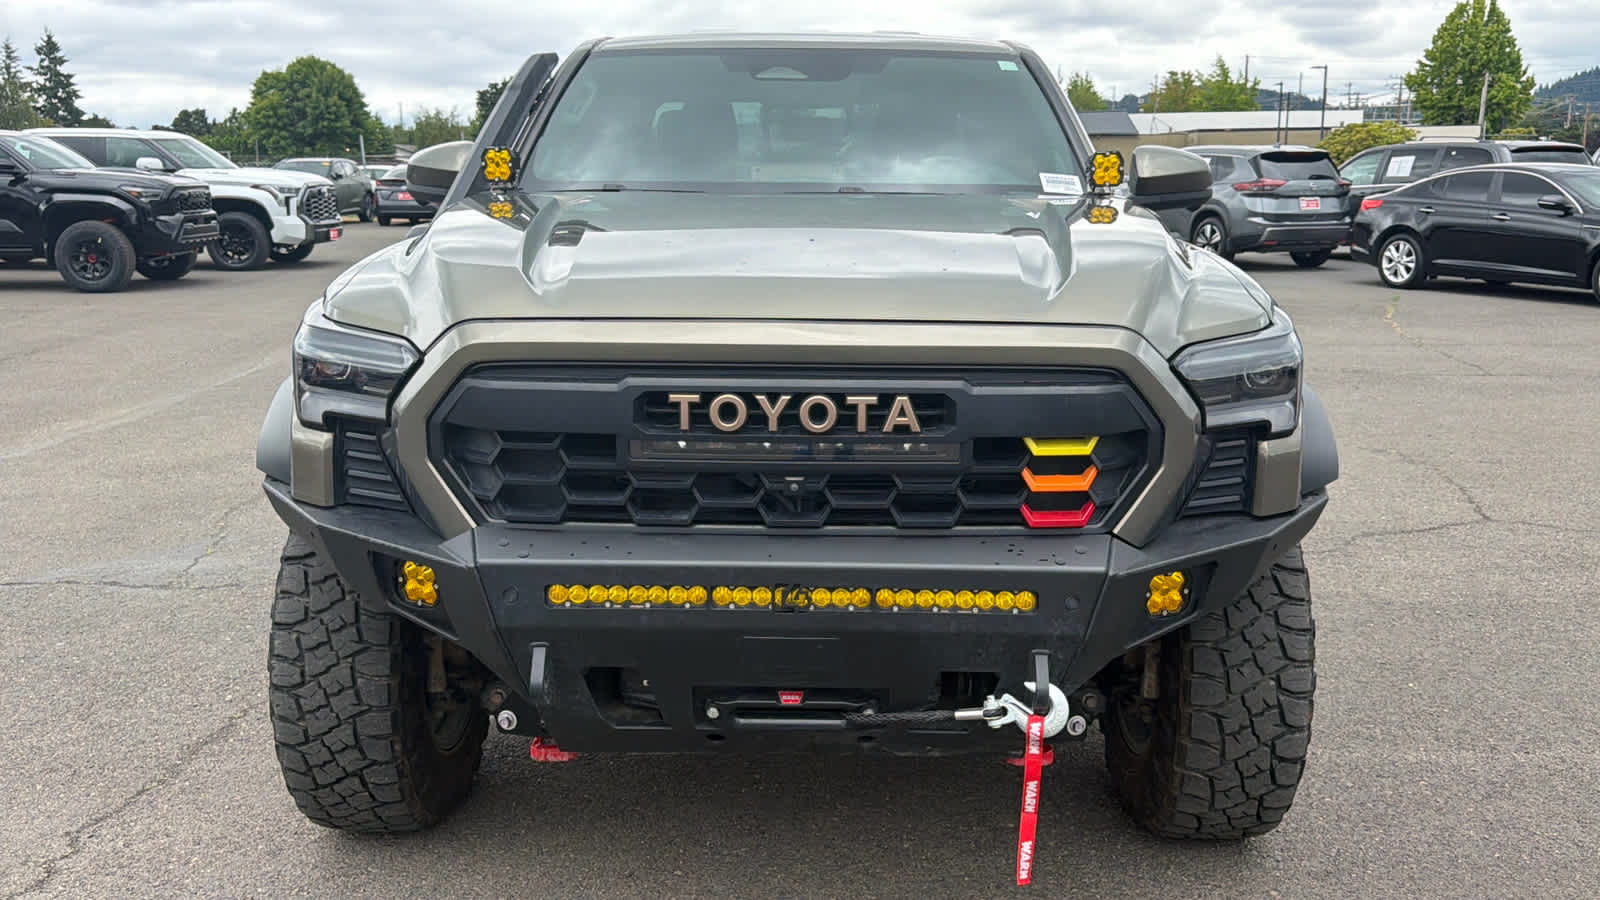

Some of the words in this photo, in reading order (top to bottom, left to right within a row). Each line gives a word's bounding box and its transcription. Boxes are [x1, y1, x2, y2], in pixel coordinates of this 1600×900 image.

[668, 394, 921, 433] TOYOTA
[1028, 721, 1042, 754] WARN
[1024, 780, 1038, 813] WARN
[1019, 840, 1032, 880] WARN
